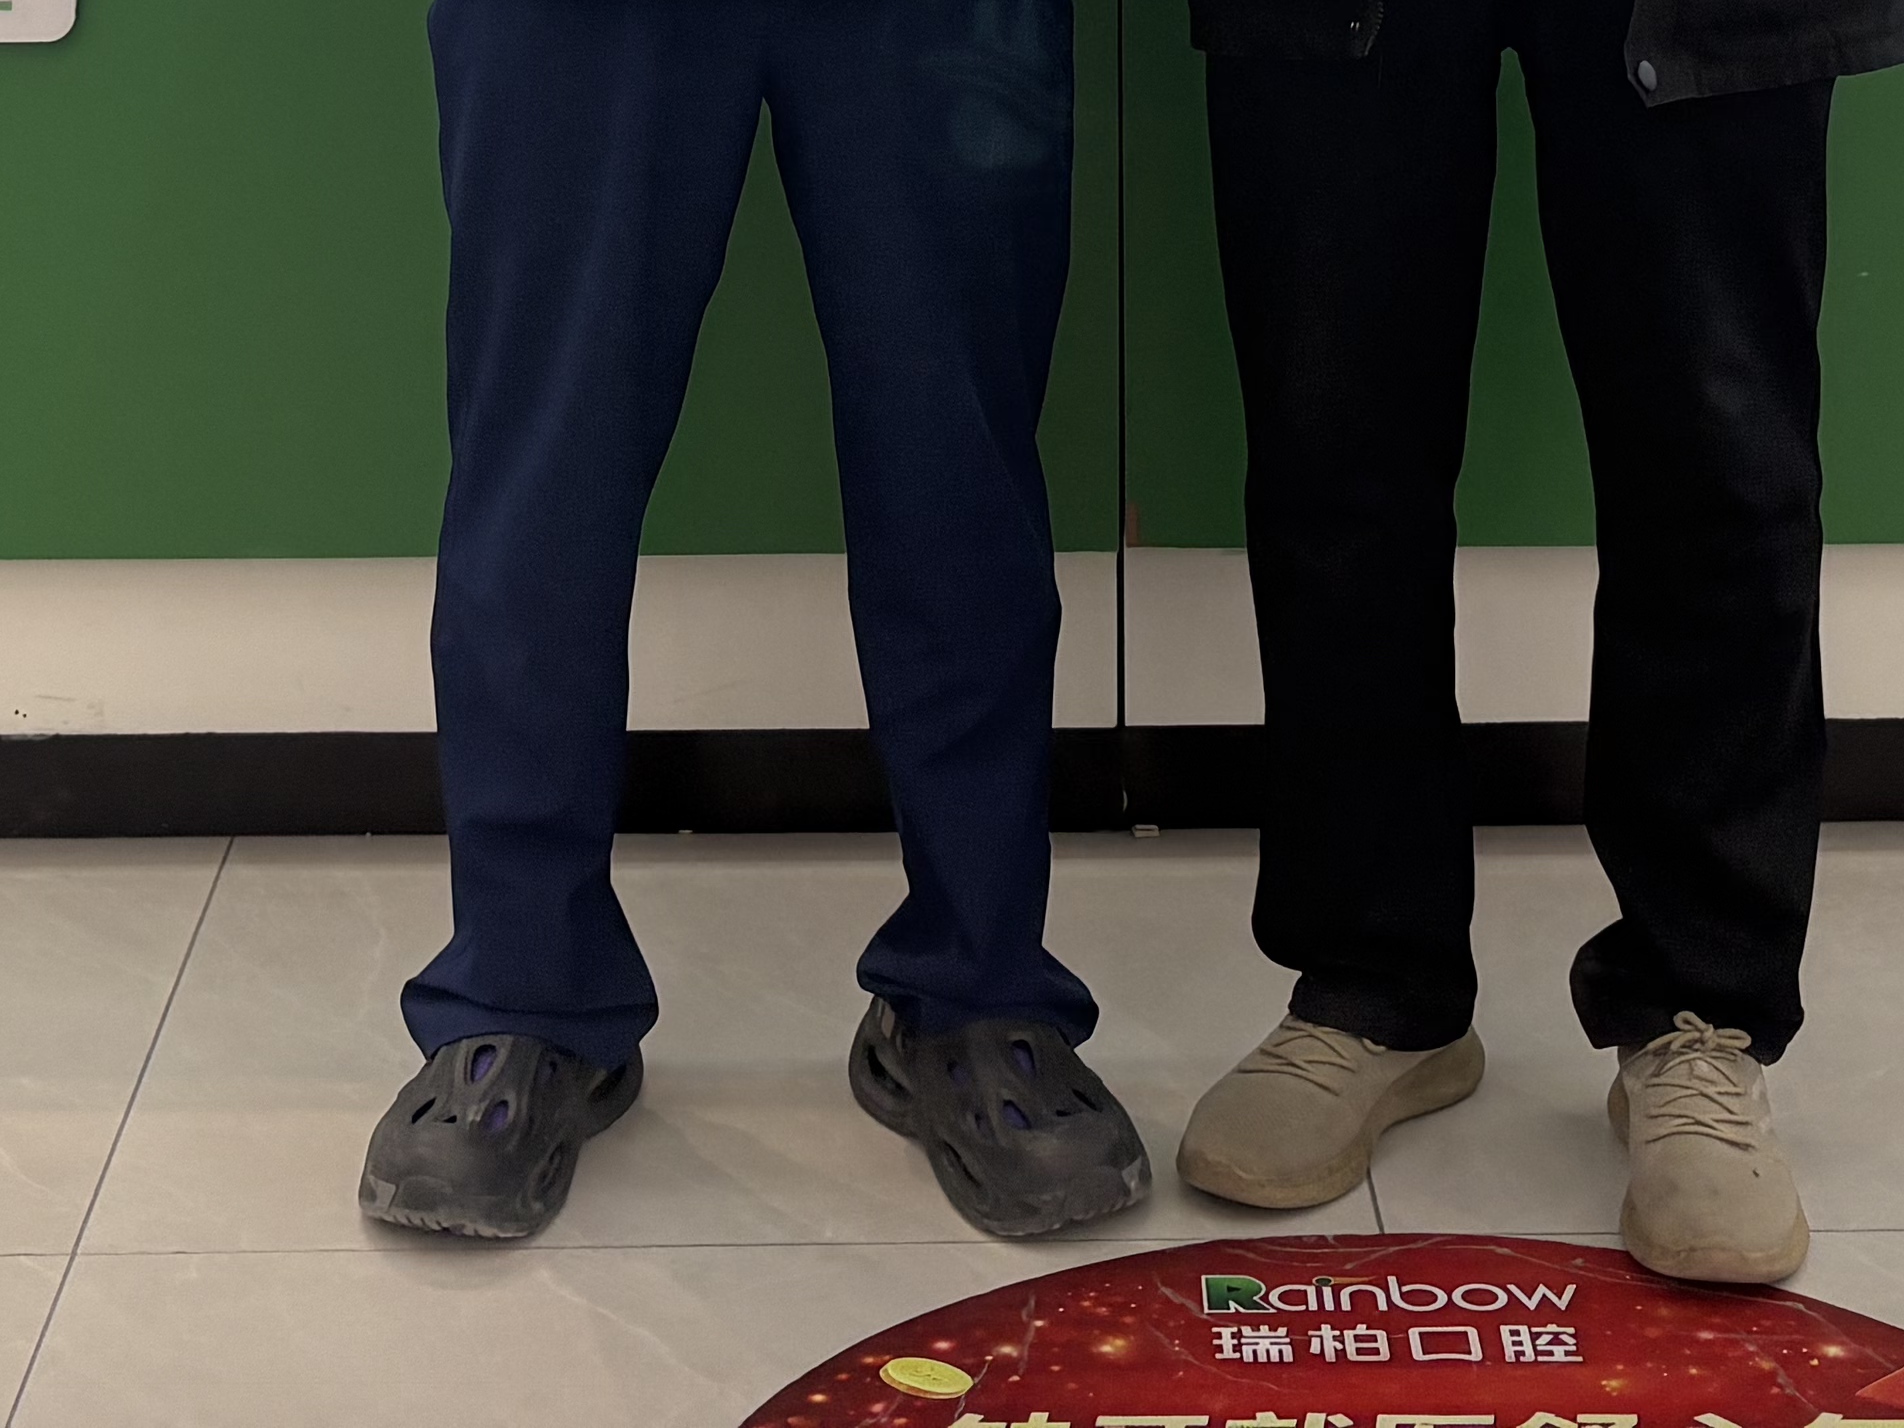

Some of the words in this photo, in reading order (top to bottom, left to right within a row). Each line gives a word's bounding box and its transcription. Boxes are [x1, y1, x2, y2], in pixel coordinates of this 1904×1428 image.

[1200, 1273, 1577, 1314] Rainbow
[1211, 1323, 1584, 1363] 瑞柏口腔
